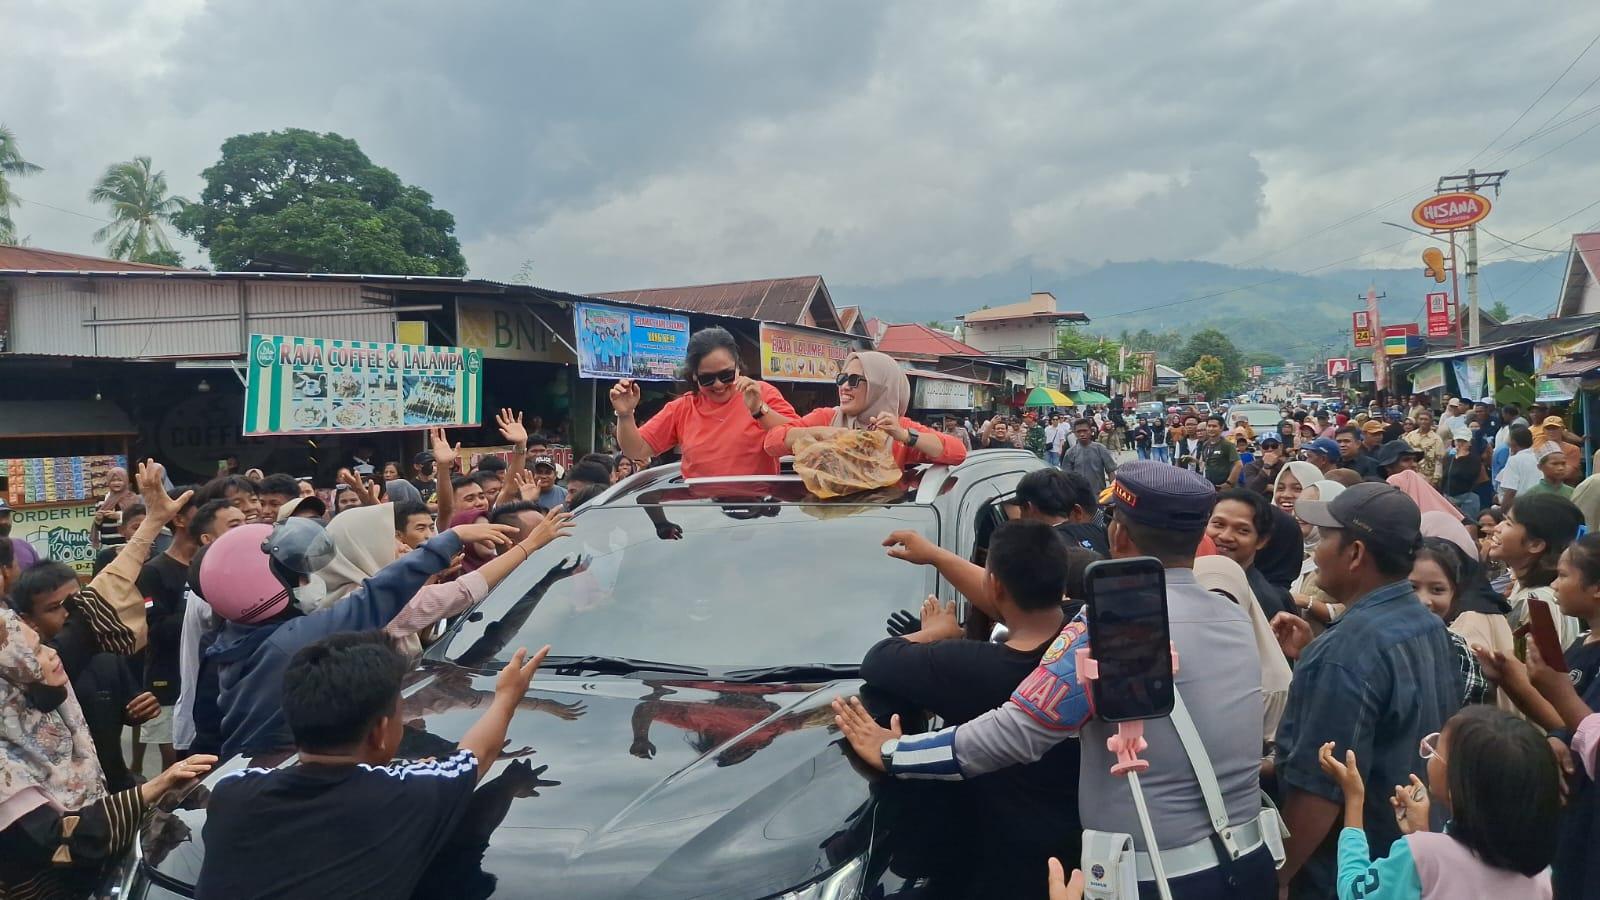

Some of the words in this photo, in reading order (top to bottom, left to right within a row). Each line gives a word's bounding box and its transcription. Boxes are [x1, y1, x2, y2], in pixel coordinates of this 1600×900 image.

[1423, 198, 1478, 220] HISANA
[1357, 332, 1368, 340] 24
[280, 343, 323, 367] RAJA
[328, 348, 384, 368] COFFEE
[388, 351, 399, 369] &
[402, 351, 465, 371] LALAMPA
[13, 508, 70, 523] ORDER
[76, 506, 97, 518] HE
[51, 528, 92, 544] Alpuk
[49, 543, 97, 561] KOCO
